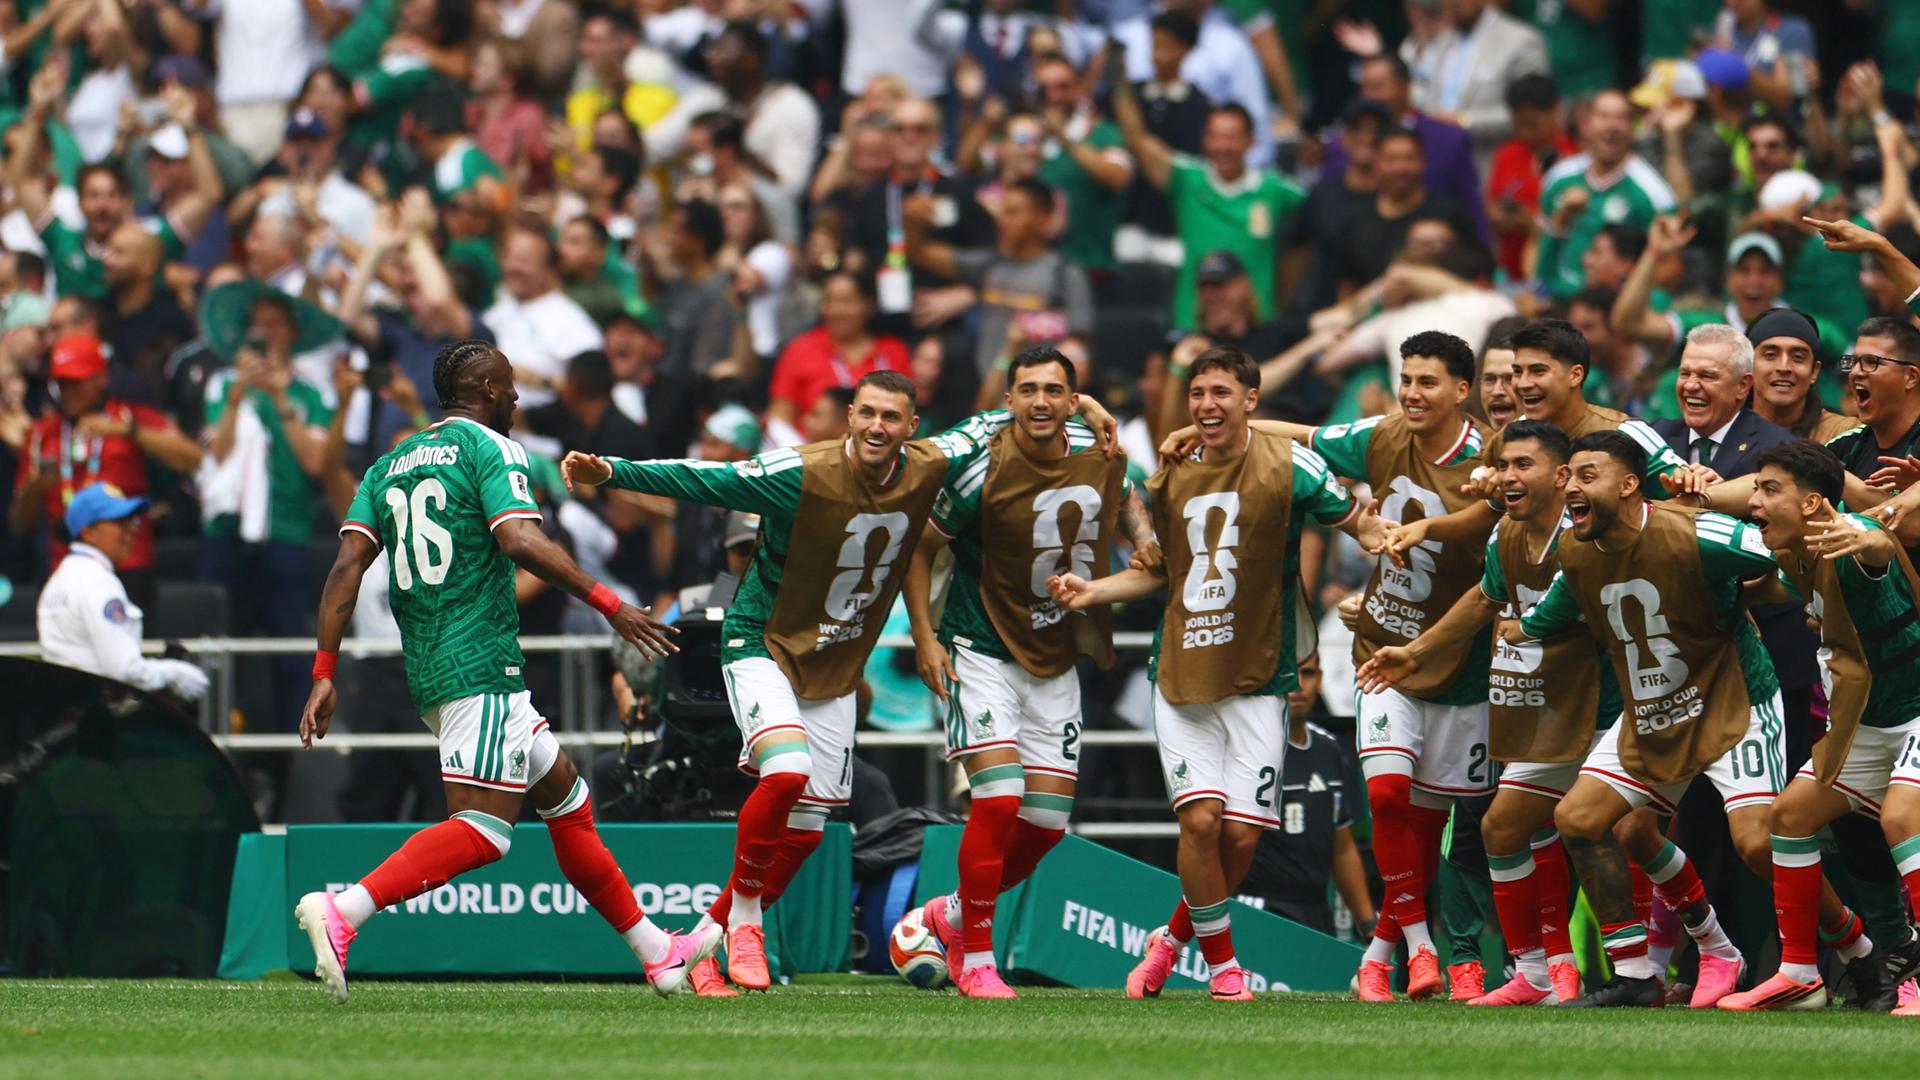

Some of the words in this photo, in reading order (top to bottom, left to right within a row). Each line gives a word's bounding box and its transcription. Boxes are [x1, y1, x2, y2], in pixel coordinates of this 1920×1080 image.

[386, 477, 453, 590] 16
[1384, 568, 1411, 590] FIFA
[1200, 586, 1225, 599] IFA
[844, 599, 867, 611] FI
[1365, 595, 1421, 639] 2026
[1400, 605, 1425, 620] CUP
[1031, 608, 1066, 630] 20
[815, 624, 864, 651] 226
[1489, 674, 1515, 687] RLD
[1517, 678, 1545, 688] CUP
[1639, 673, 1671, 688] FIFA
[1489, 687, 1546, 707] 026
[1673, 686, 1698, 704] CUP
[1636, 698, 1704, 735] 2026
[1062, 721, 1079, 761] 2
[840, 747, 850, 786] 1
[1731, 739, 1764, 780] 10
[405, 883, 525, 915] WORLD
[632, 882, 722, 915] 026
[1062, 900, 1117, 949] FIFA
[1122, 921, 1211, 983] WLD
